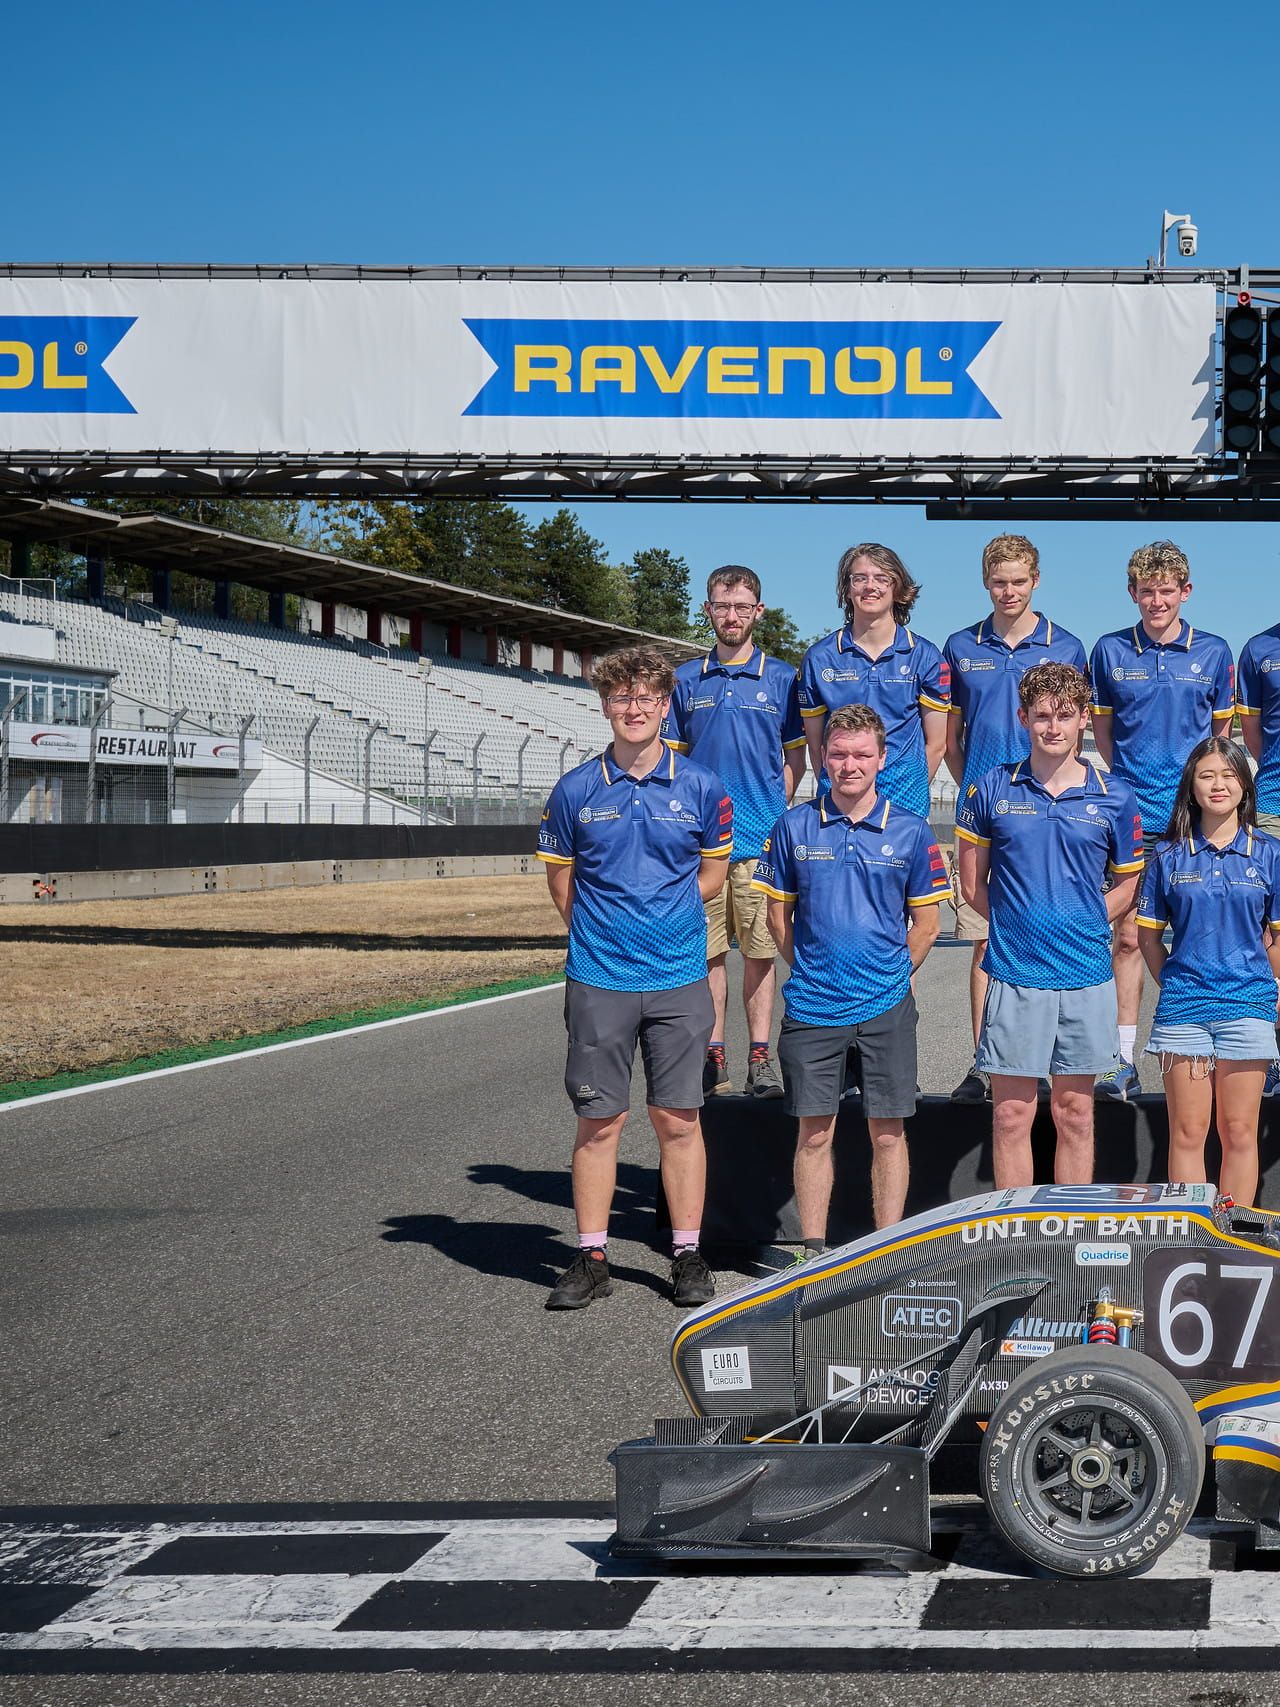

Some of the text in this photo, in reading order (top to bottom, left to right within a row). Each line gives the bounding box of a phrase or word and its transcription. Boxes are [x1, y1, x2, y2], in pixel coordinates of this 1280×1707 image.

[961, 1214, 1190, 1245] UNI OF BATH
[1081, 1250, 1129, 1263] Quadrise
[892, 1307, 953, 1327] ATEC
[1159, 1263, 1274, 1369] 67
[1017, 1343, 1052, 1353] Kellaway
[713, 1352, 739, 1370] EURO
[713, 1376, 744, 1386] CIRCUITS
[869, 1368, 940, 1387] ANALOG
[979, 1380, 1009, 1391] AX3D
[993, 1373, 1095, 1454] Hoosier
[1083, 1494, 1185, 1573] Hoosier
